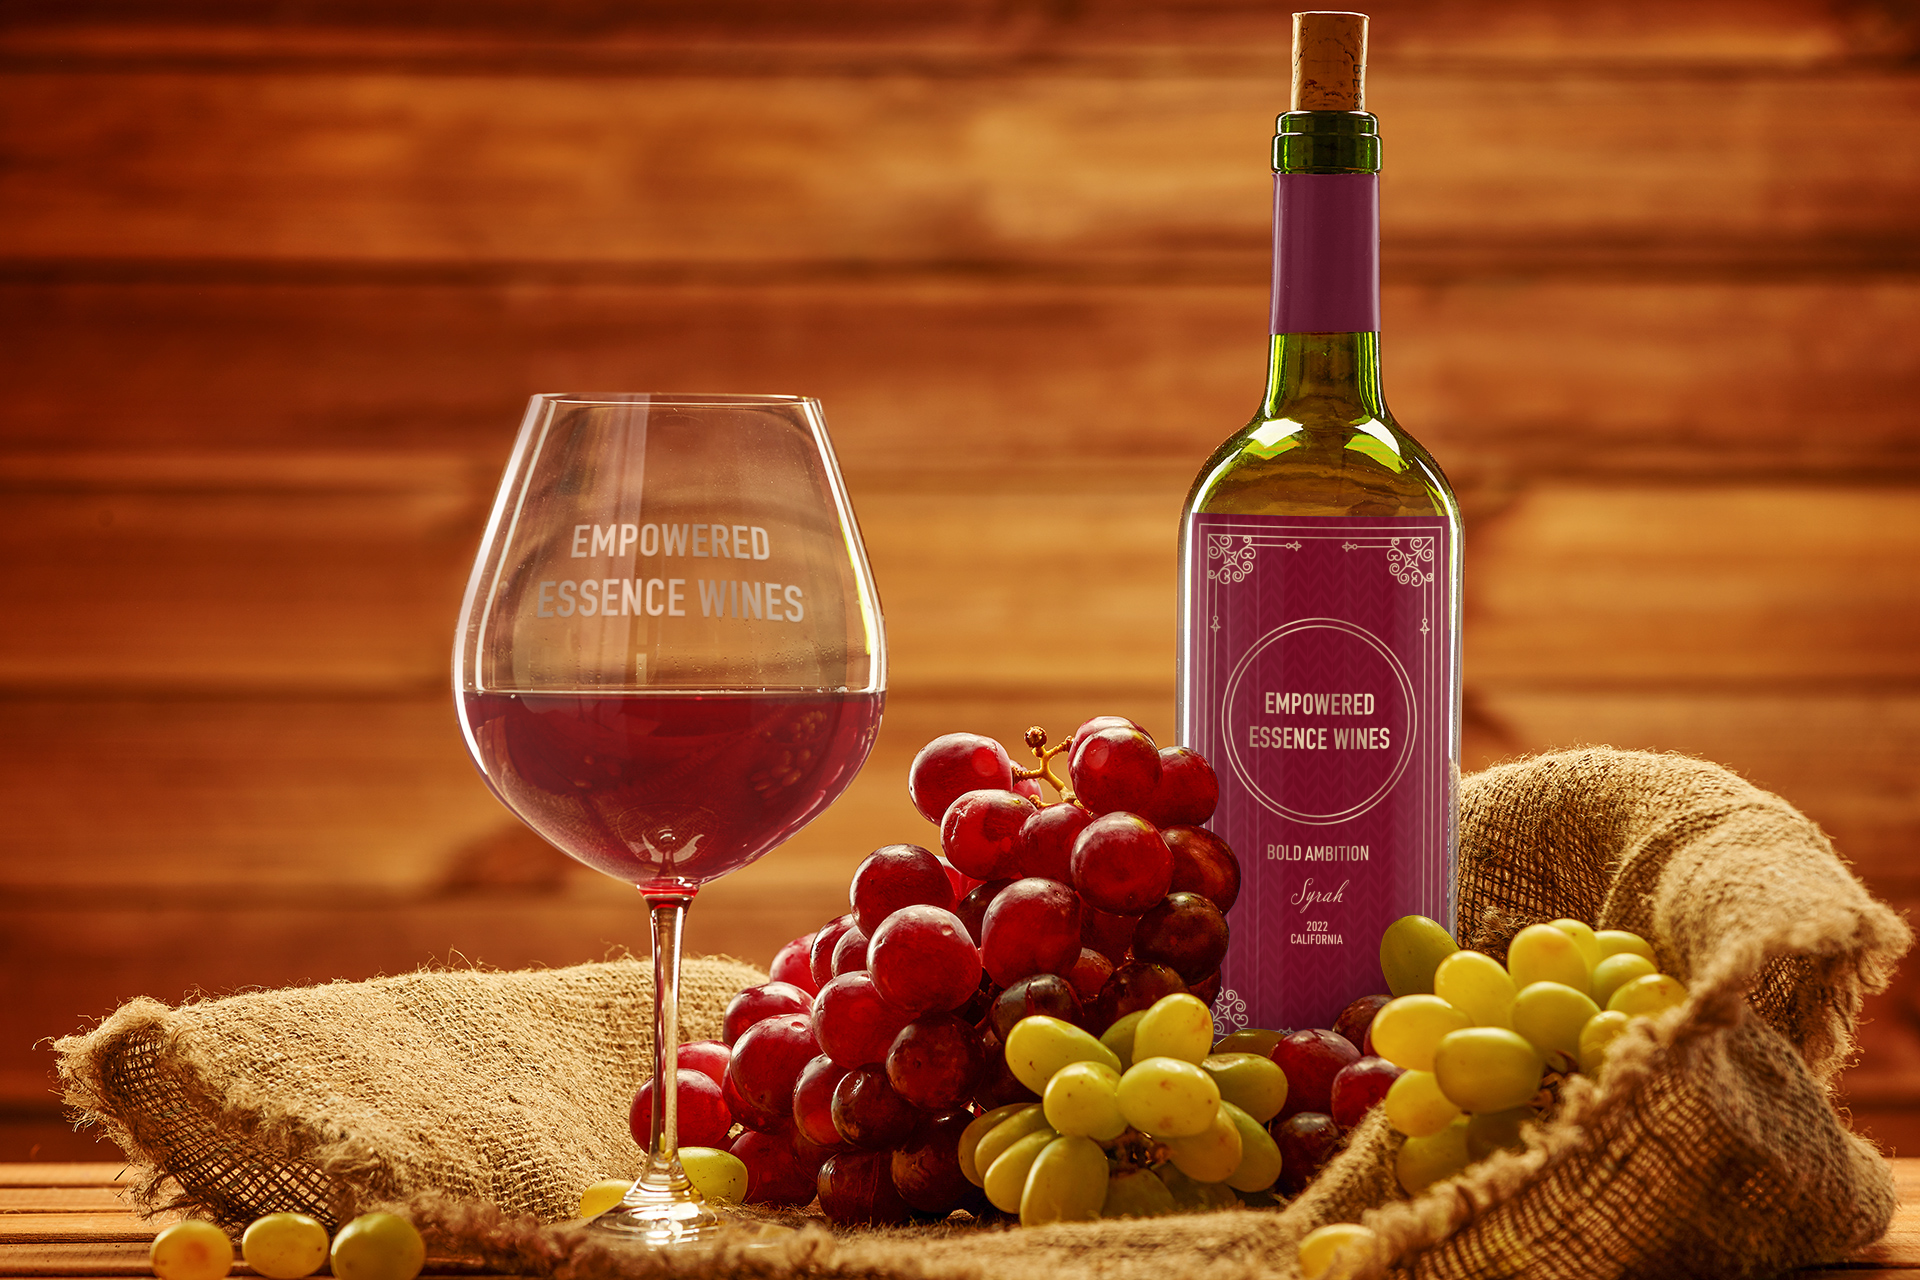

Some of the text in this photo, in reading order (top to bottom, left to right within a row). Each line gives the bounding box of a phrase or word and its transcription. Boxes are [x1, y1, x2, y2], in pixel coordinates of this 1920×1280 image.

[570, 523, 770, 561] EMPOWERED
[536, 578, 804, 622] ESSENCE WINES
[1265, 691, 1375, 715] EMPOWERED
[1249, 726, 1390, 750] ESSENCE WINES
[1267, 844, 1369, 861] BOLD AMBITION
[1290, 877, 1350, 914] Syrah
[1306, 921, 1329, 932] 2022
[1290, 933, 1344, 945] CALIFORNIA
